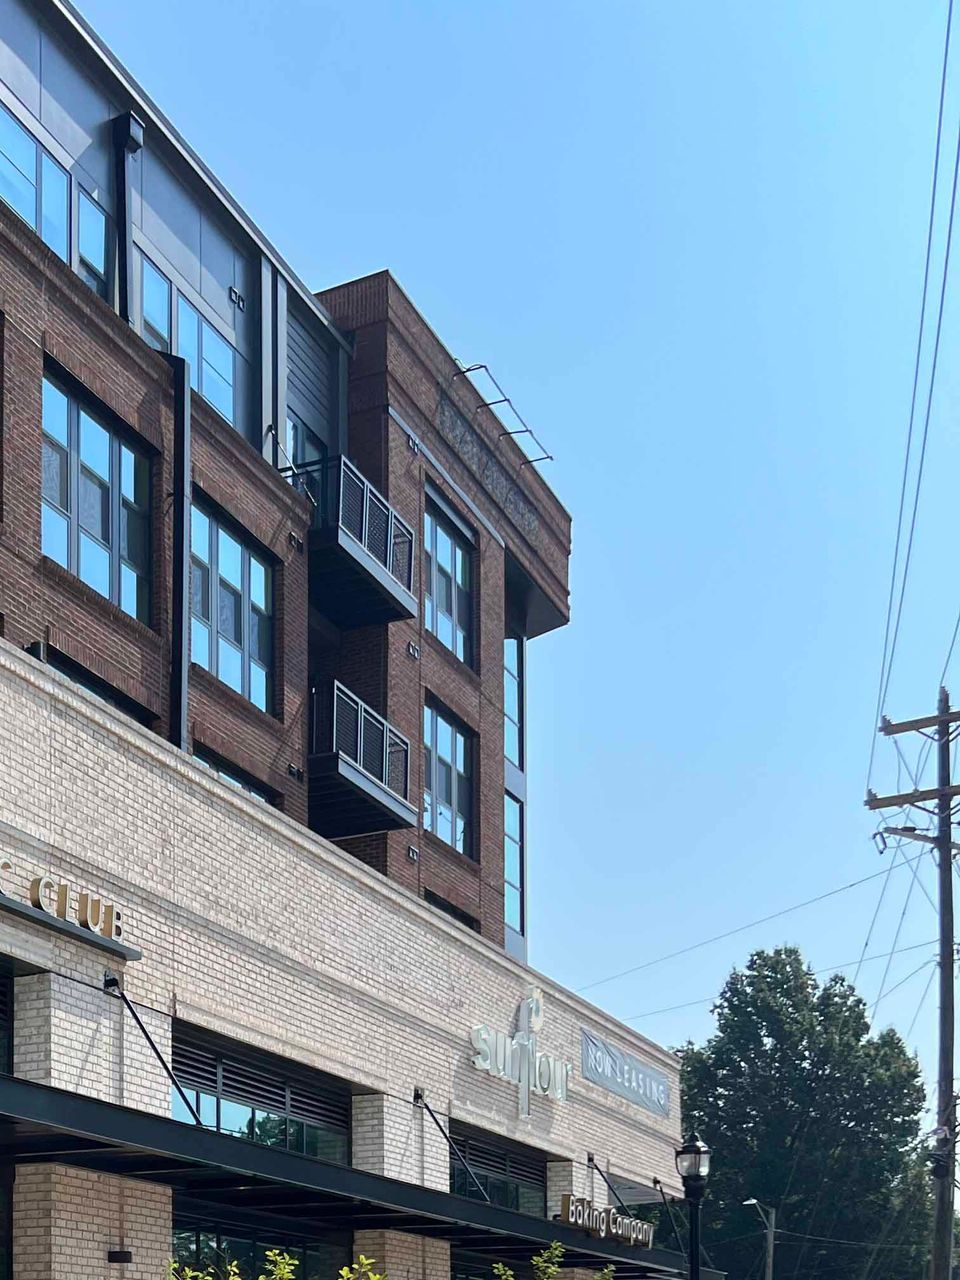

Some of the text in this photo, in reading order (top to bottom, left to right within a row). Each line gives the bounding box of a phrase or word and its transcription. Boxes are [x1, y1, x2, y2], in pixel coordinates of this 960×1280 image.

[29, 875, 125, 942] CLUB
[587, 1044, 665, 1105] NOW LEASING
[565, 1194, 653, 1249] Baking Company
